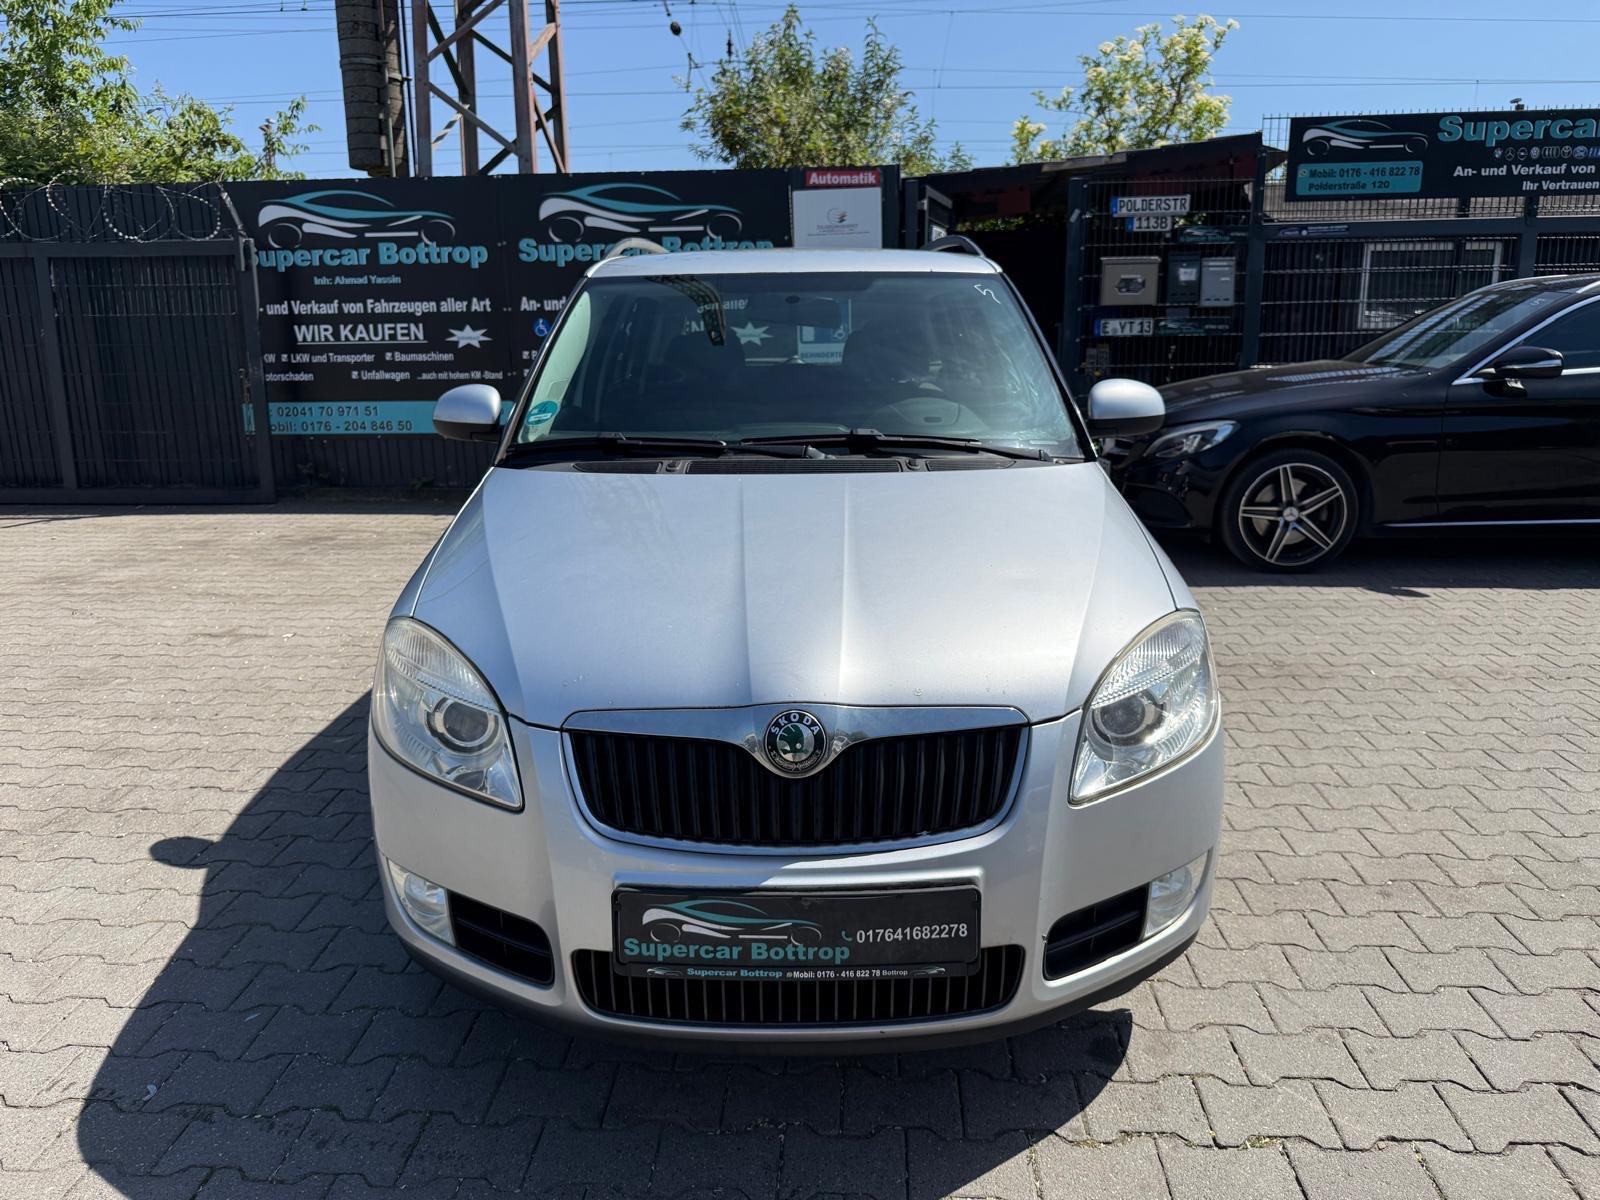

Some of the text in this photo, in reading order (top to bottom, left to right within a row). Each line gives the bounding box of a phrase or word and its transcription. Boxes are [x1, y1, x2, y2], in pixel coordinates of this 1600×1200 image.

[1437, 115, 1600, 147] Superca
[1309, 168, 1336, 178] Mobil:
[1339, 167, 1361, 177] 0176
[1369, 167, 1386, 177] 416
[1389, 166, 1406, 176] 822
[1409, 166, 1420, 176] 78
[1453, 163, 1595, 176] An- und Verkauf von
[809, 172, 876, 185] Automatik
[1522, 179, 1600, 191] Ihr Vertrauen
[1308, 180, 1390, 191] Polderstraße 120
[1118, 197, 1188, 212] POLDERSTR
[378, 241, 489, 269] Bottrop
[518, 237, 650, 267] Super
[313, 274, 401, 285] Inh: Ahmad Yassin
[266, 296, 492, 317] und Verkauf von Fahrzeugen aller Art
[520, 296, 541, 311] An-
[293, 323, 425, 342] WIR KAUFEN
[1102, 321, 1110, 334] E
[290, 353, 311, 363] LKW
[311, 353, 328, 363] und
[328, 353, 376, 364] Transporter
[394, 351, 454, 361] Baumaschinen
[361, 370, 411, 382] Unfallwagen
[438, 371, 448, 380] mit
[449, 371, 470, 379] hohen
[470, 370, 482, 379] KM
[277, 406, 378, 416] 02041 70 971 51
[301, 421, 332, 432] 0176
[344, 421, 366, 431] 204
[371, 420, 393, 431] 846
[398, 420, 412, 431] 50
[770, 712, 820, 736] SKODA
[856, 923, 968, 944] 017641682278
[623, 937, 850, 965] Supercar Bottrop
[687, 967, 738, 977] Supercar
[740, 968, 783, 979] Bottrop
[793, 970, 815, 978] Mobil:
[816, 970, 835, 978] 0176
[841, 969, 855, 977] 416
[856, 969, 870, 977] 822
[871, 969, 881, 977] 78
[882, 969, 908, 977] Bottrop
